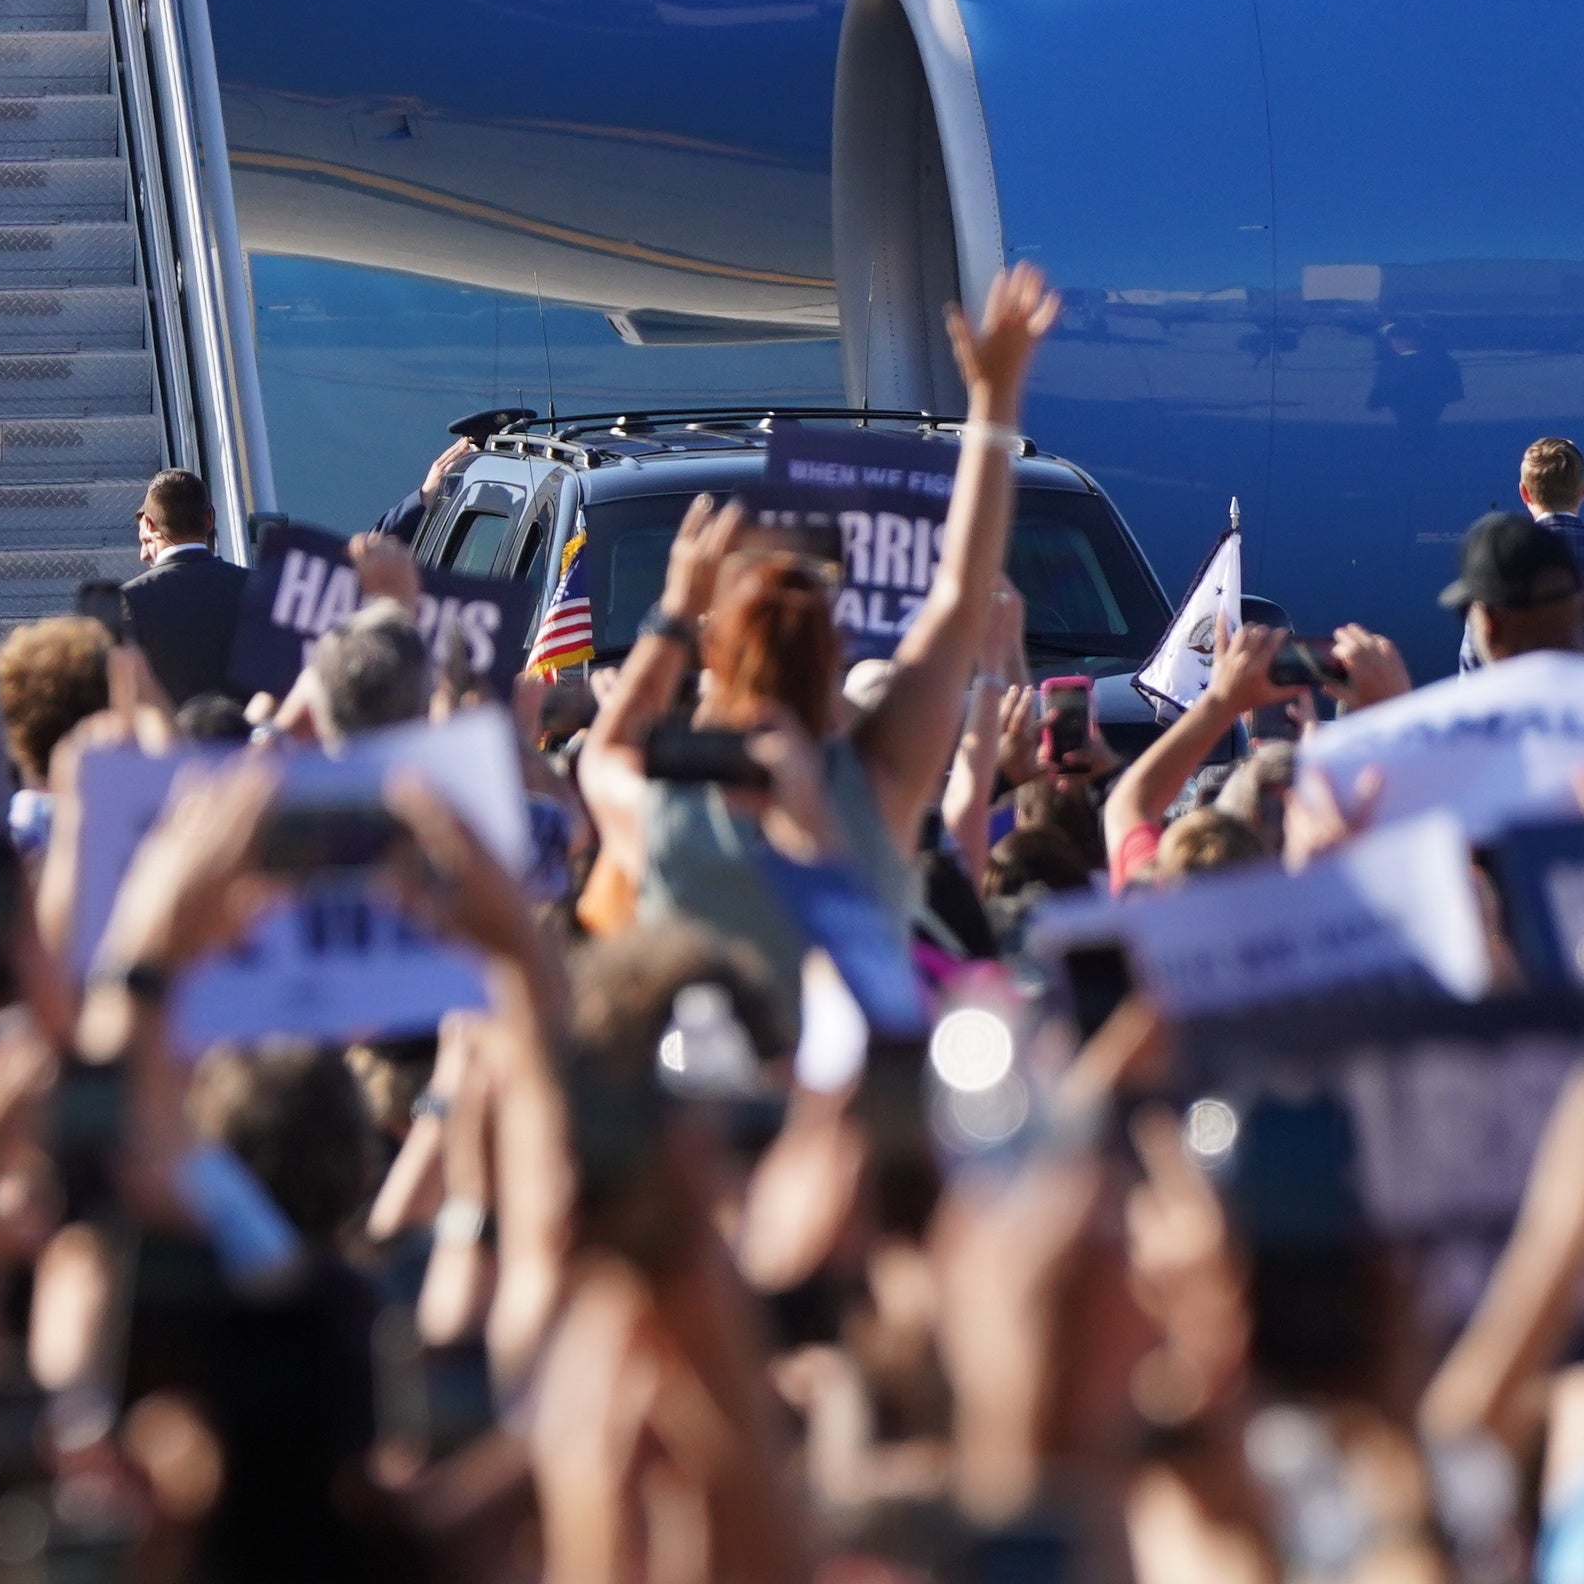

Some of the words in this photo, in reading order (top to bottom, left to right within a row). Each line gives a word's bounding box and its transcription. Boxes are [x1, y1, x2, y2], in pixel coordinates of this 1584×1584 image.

[787, 459, 857, 487] WHEN
[908, 469, 955, 499] FIG
[831, 586, 929, 636] ALZ
